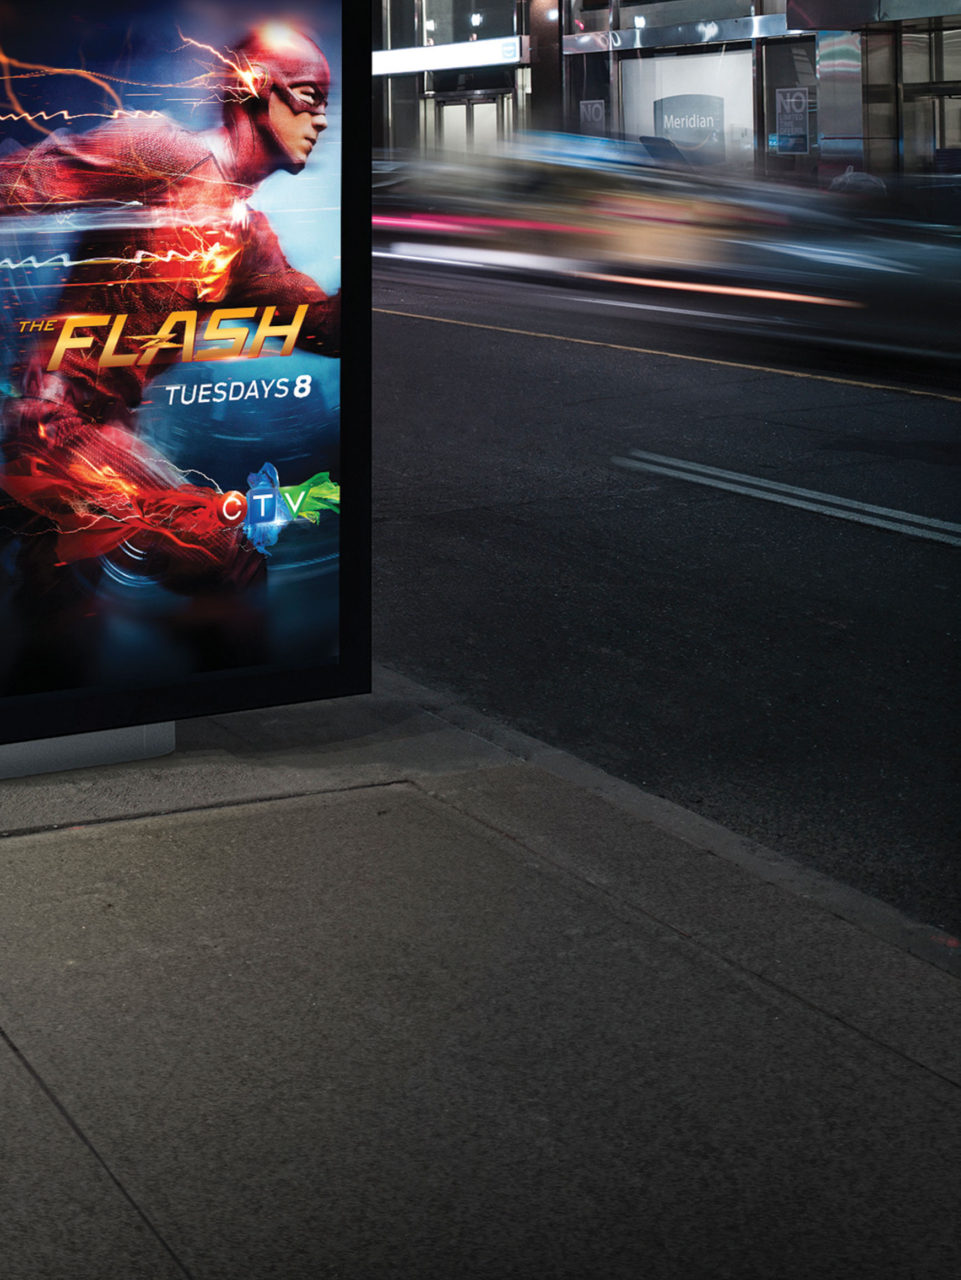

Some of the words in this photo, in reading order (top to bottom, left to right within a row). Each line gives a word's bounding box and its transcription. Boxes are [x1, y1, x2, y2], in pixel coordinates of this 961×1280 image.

[581, 103, 602, 122] NO
[777, 91, 805, 113] NO
[664, 114, 714, 129] Meridian
[19, 319, 58, 333] THE
[47, 304, 309, 371] FLASH
[165, 378, 289, 405] TUESDAYS
[293, 375, 312, 398] 8
[222, 491, 307, 520] CTV
